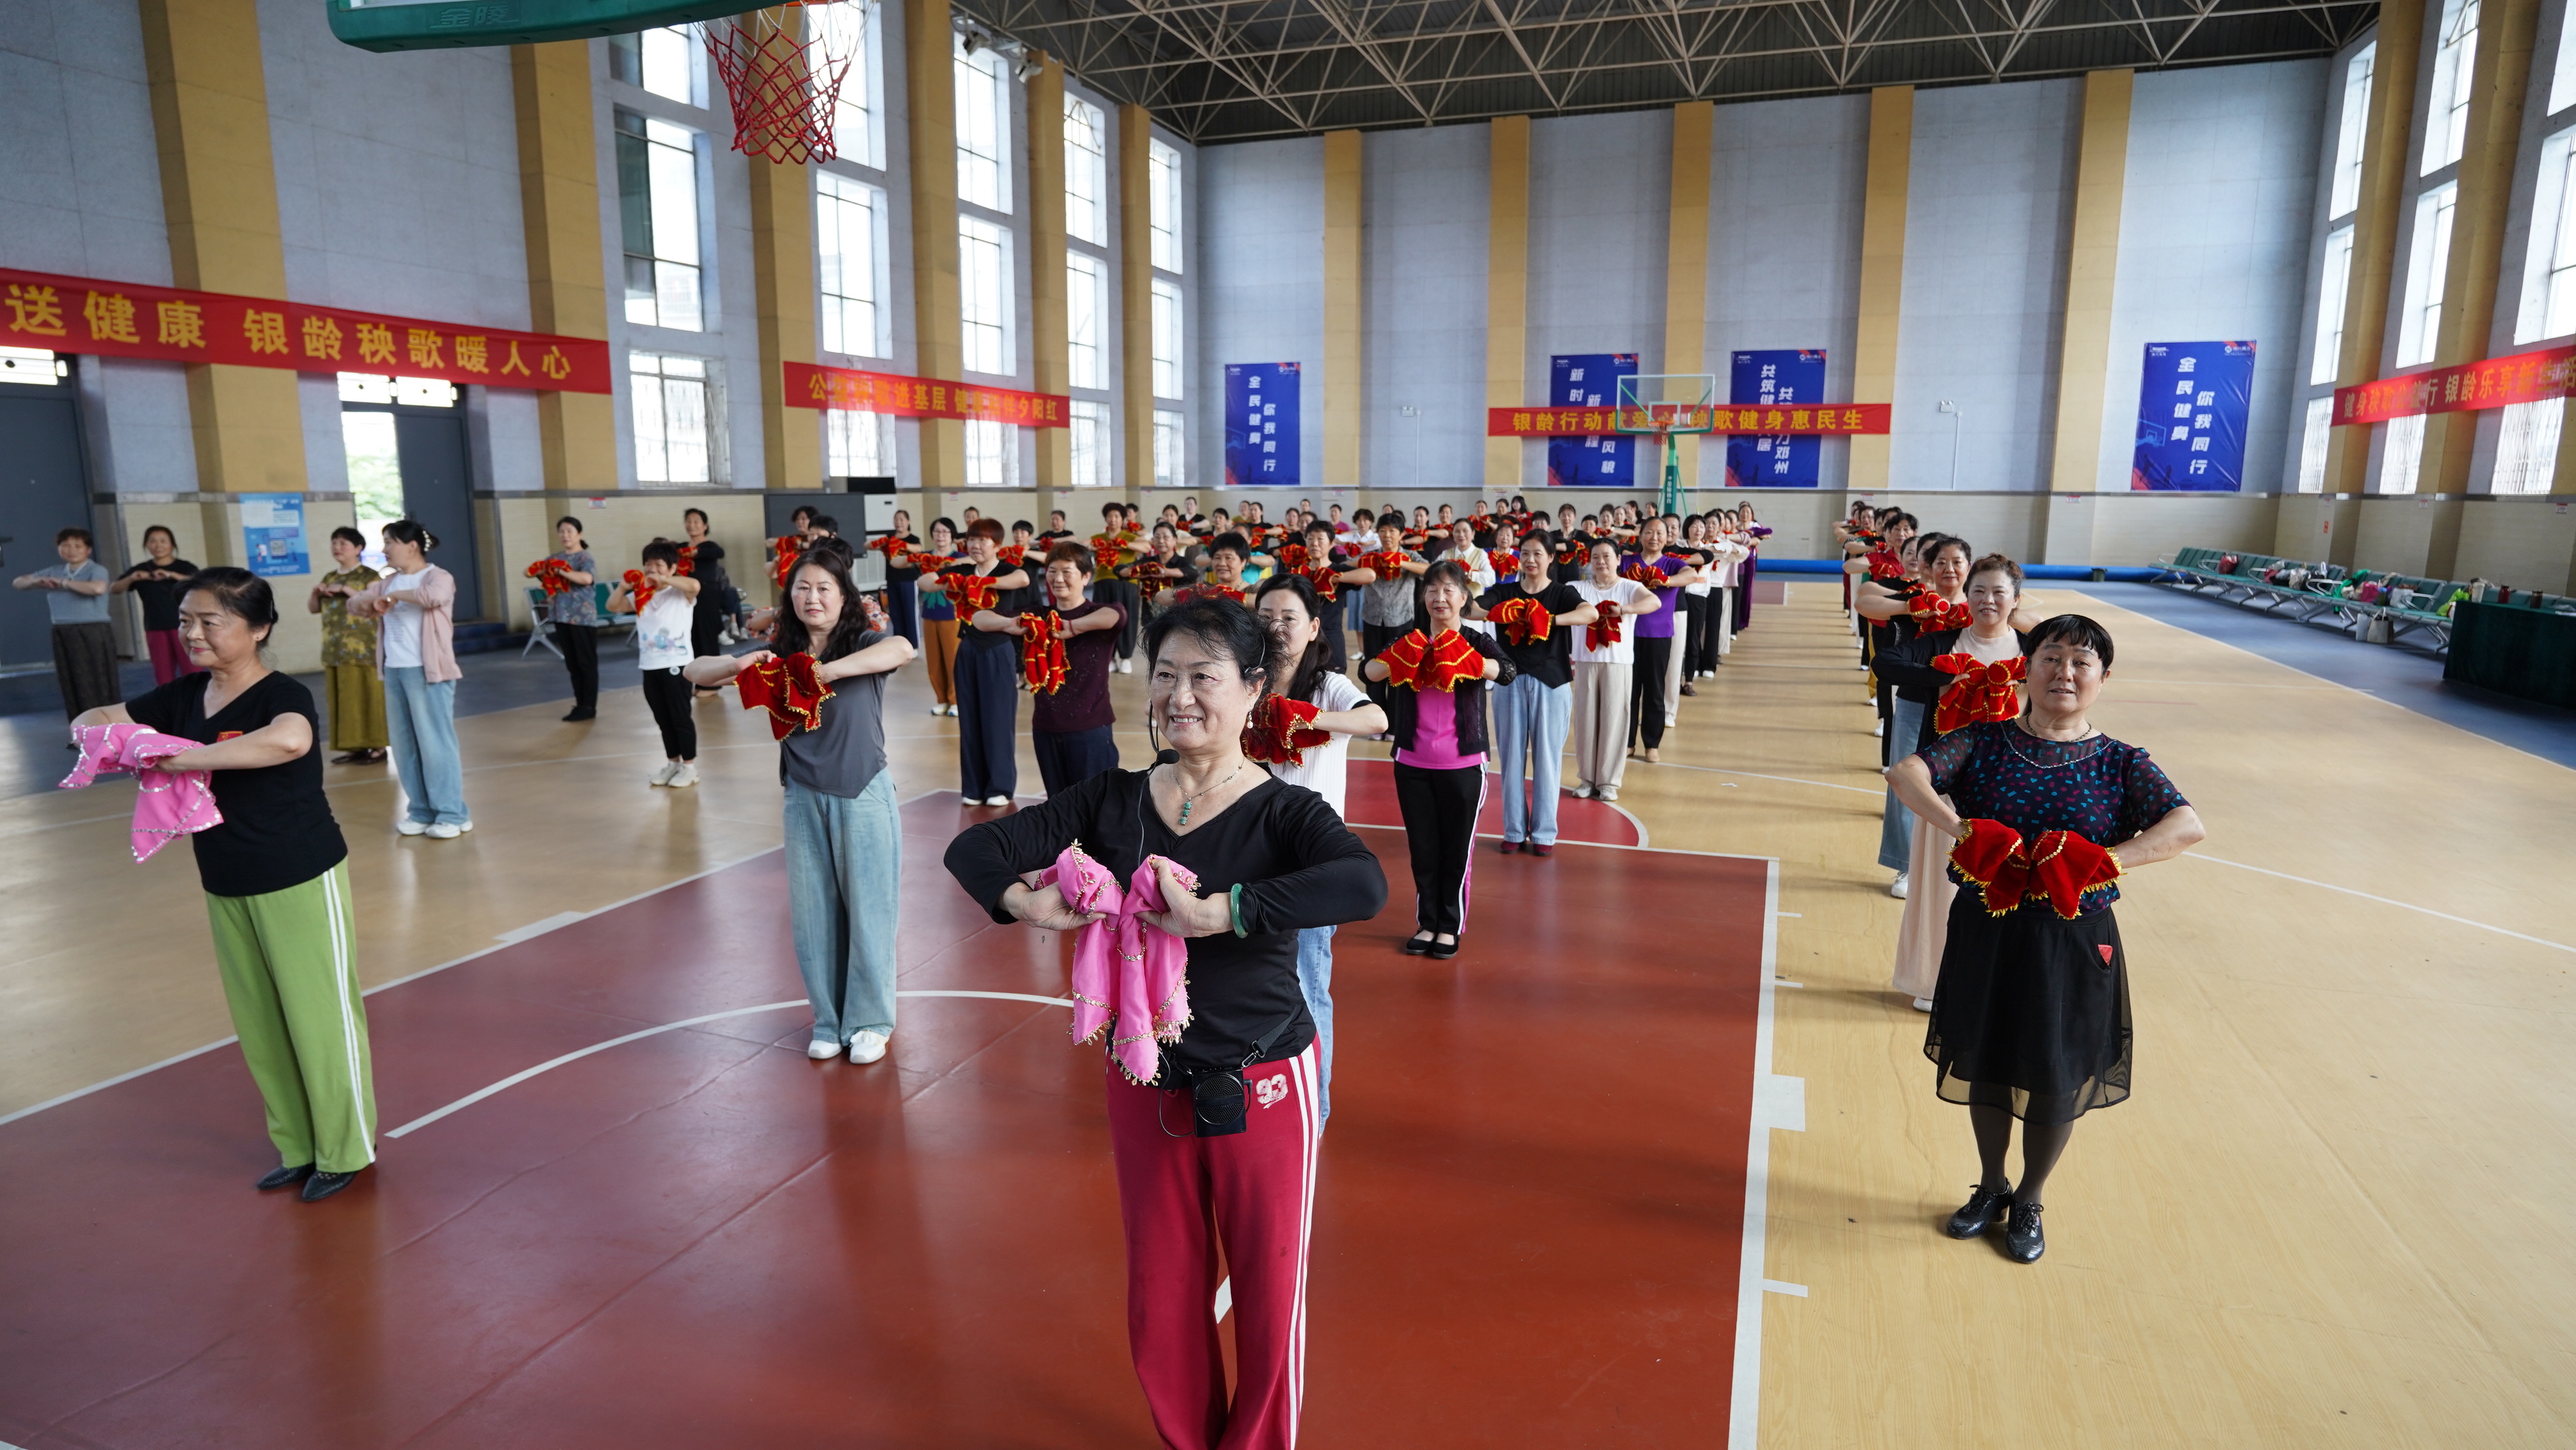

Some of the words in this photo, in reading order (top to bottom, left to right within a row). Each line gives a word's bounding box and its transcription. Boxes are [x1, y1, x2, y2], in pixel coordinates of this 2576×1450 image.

[5, 283, 206, 349] 送健康
[243, 308, 573, 380] 银龄秧歌暖人心
[1248, 376, 1262, 444] 全民健身
[2171, 357, 2196, 441] 全民健身
[2444, 355, 2576, 404] 银龄乐享新生活
[1263, 403, 1276, 472] 你我同行
[1689, 409, 1863, 431] 秧歌健身惠民生
[2189, 391, 2215, 474] 你我同行
[1256, 1074, 1289, 1105] 93
